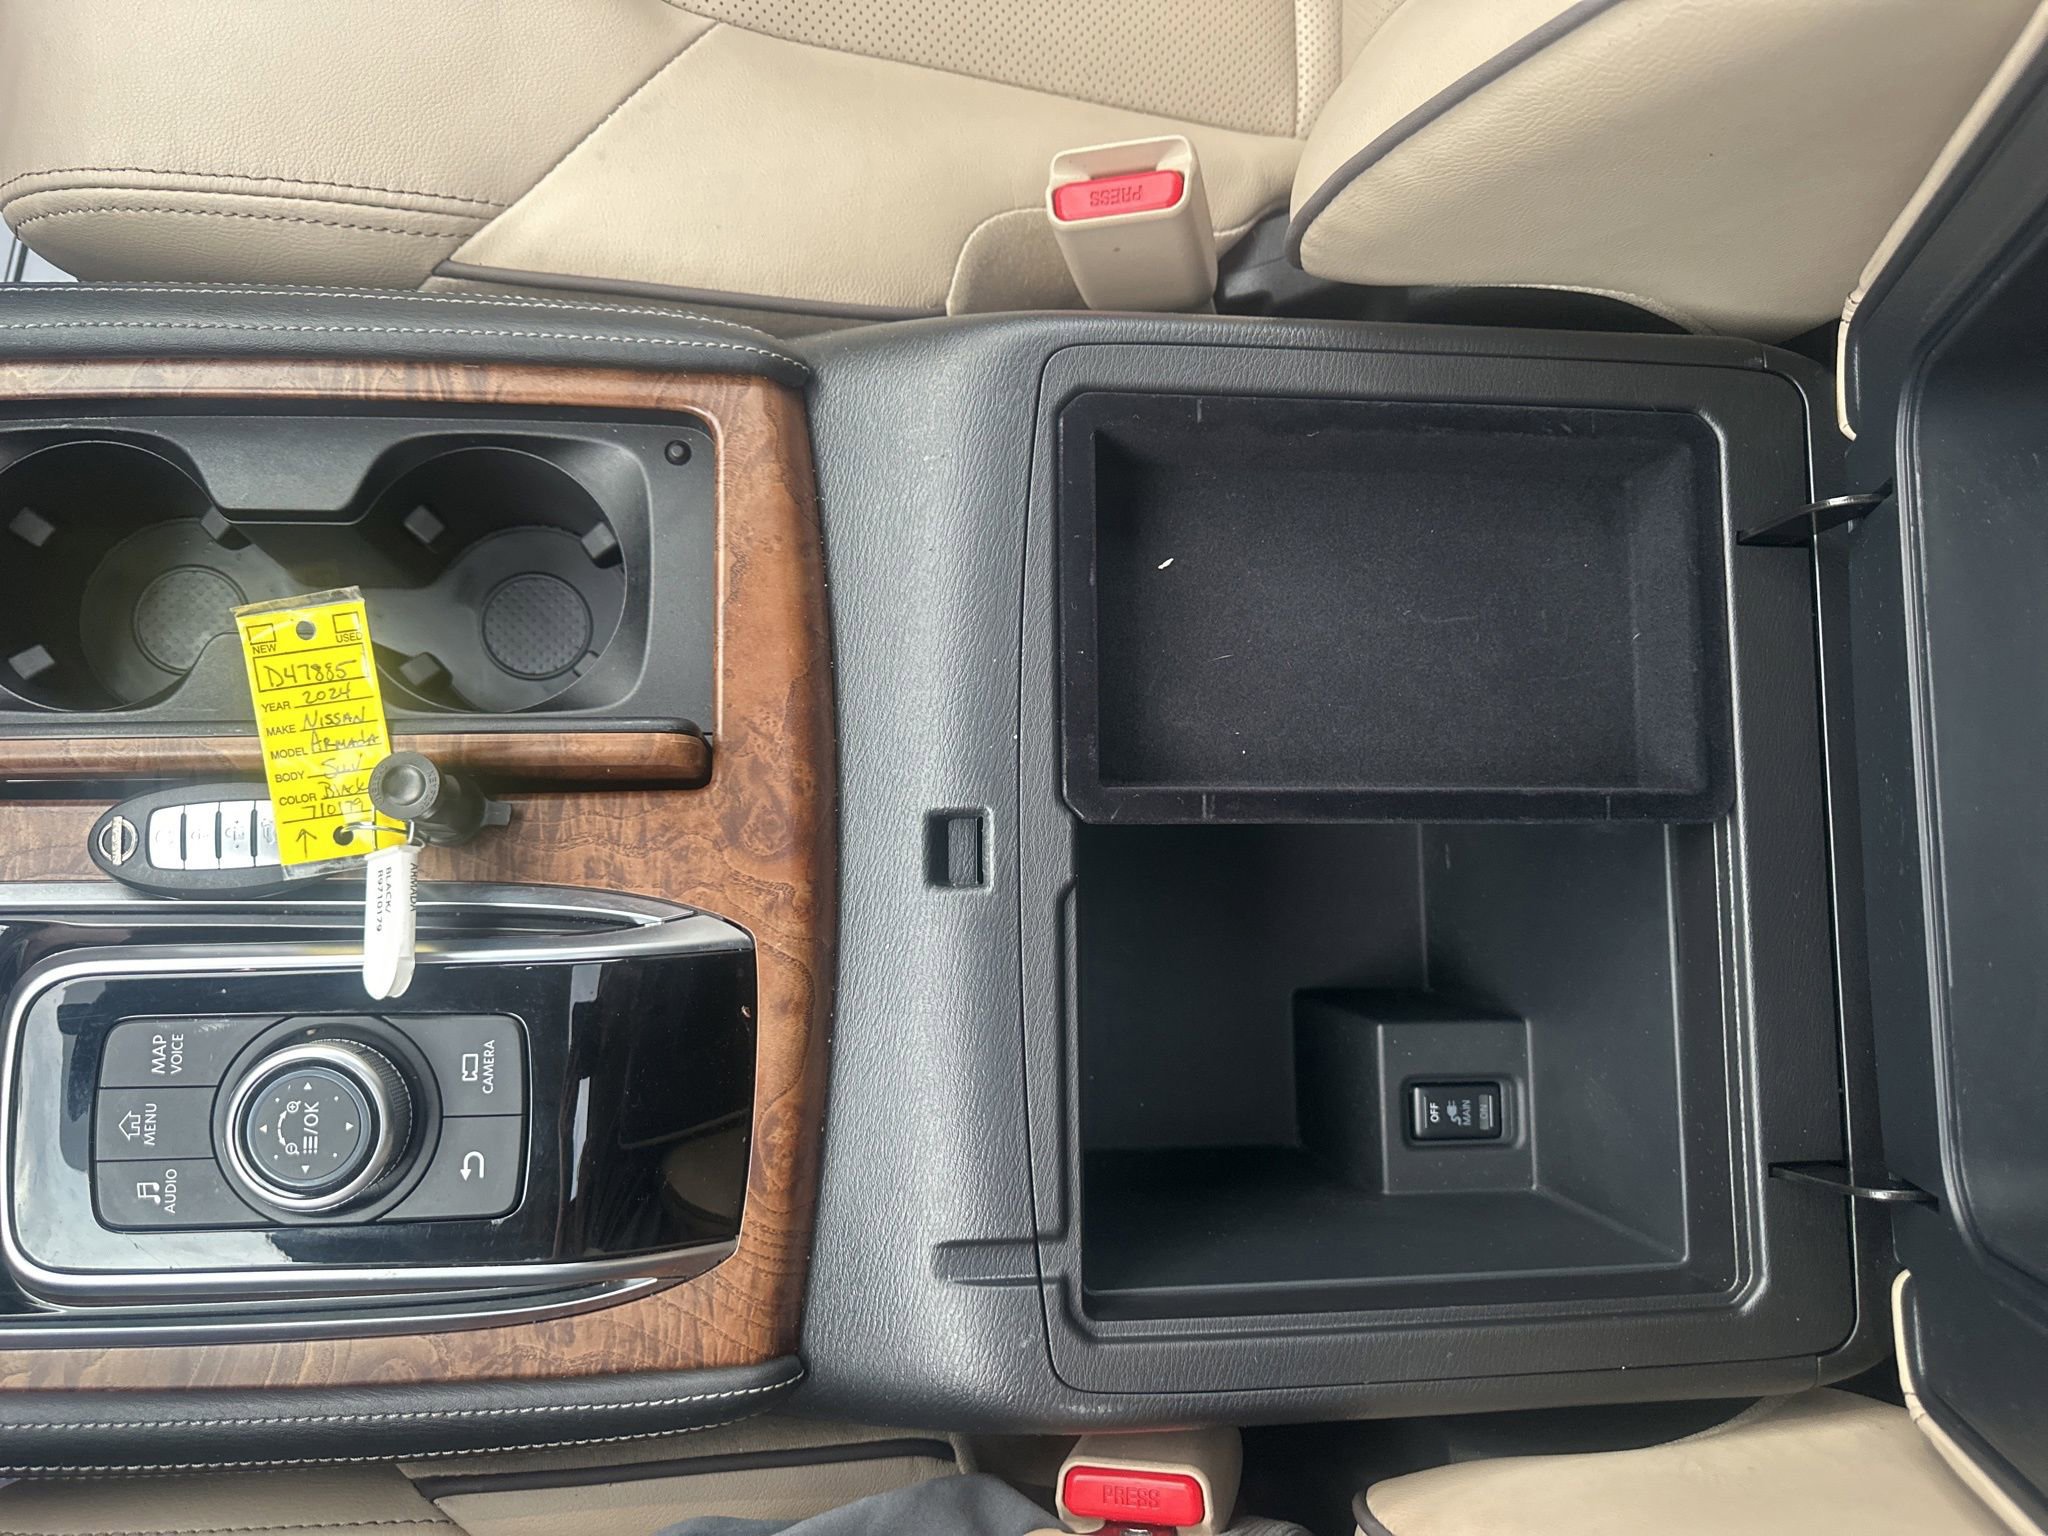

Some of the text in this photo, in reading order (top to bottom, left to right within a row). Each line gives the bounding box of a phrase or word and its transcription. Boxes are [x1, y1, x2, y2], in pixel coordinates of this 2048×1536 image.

[1090, 184, 1143, 207] PRESS
[252, 643, 277, 655] NEW
[335, 632, 363, 643] USED
[263, 659, 357, 688] D47885
[261, 682, 351, 713] YEAR 2024
[266, 724, 297, 737] MAKE
[270, 747, 309, 760] MODEL
[274, 770, 305, 783] BODY
[278, 793, 318, 807] COLOR
[409, 862, 418, 912] ARMADA
[151, 1034, 167, 1074] MAP
[170, 1033, 184, 1075] VOICE
[482, 1039, 496, 1095] CAMERA
[1429, 1102, 1440, 1123] OFF
[1462, 1099, 1471, 1126] MAIN
[1480, 1103, 1488, 1120] ON
[143, 1103, 157, 1146] MENU
[164, 1168, 178, 1214] AUDIO
[1102, 1484, 1161, 1508] PRESS
